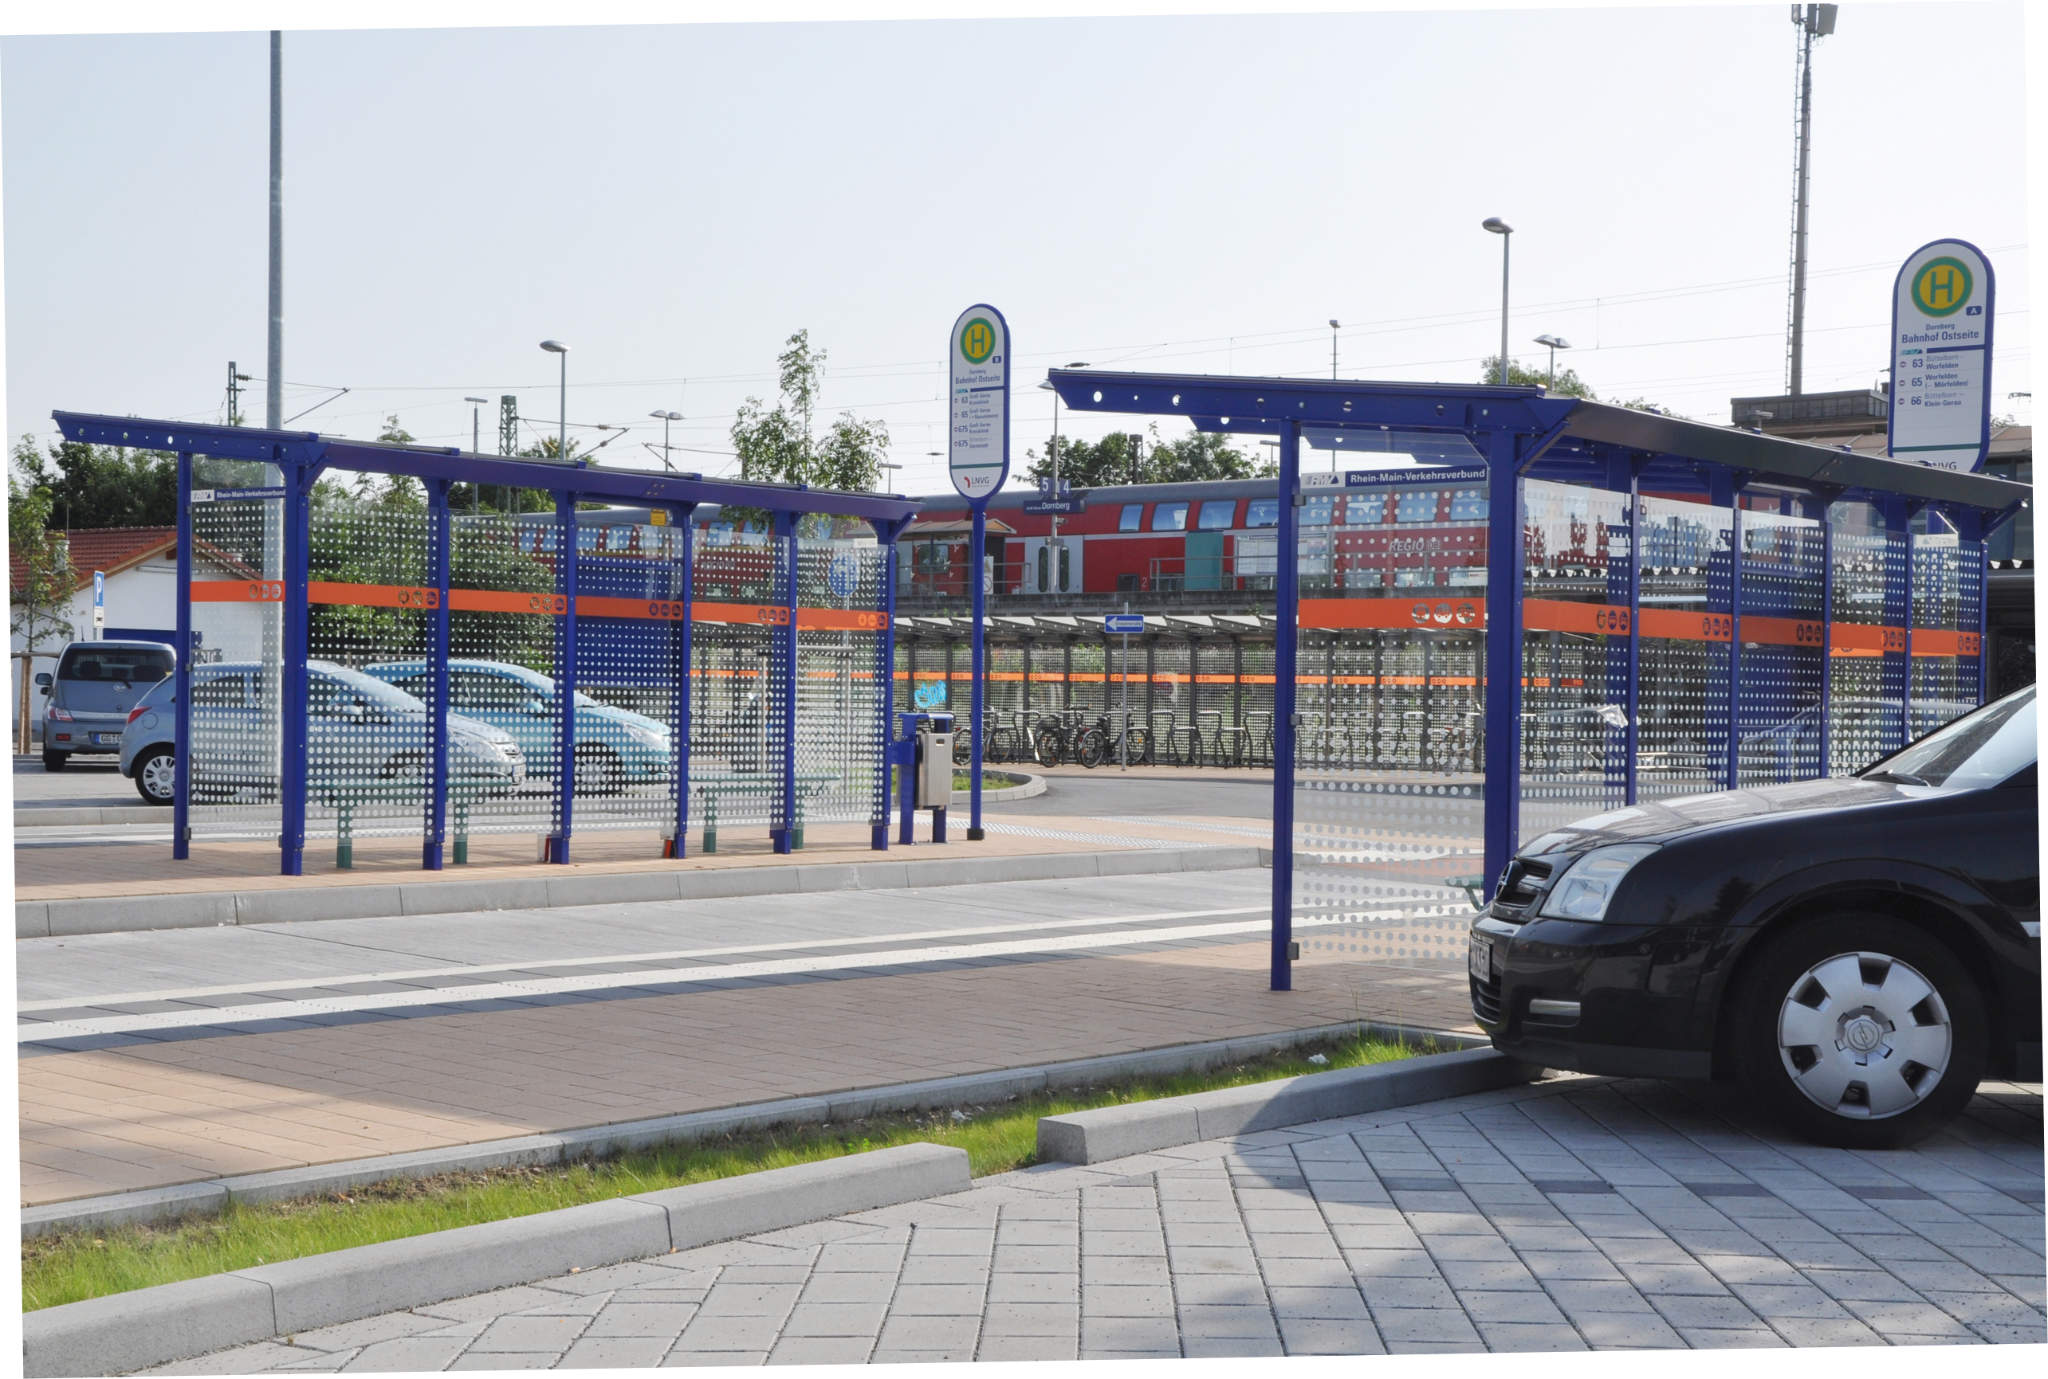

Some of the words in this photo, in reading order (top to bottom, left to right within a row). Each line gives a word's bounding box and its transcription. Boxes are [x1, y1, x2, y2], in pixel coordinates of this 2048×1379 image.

[1930, 270, 1954, 304] H
[971, 327, 985, 354] H
[1902, 332, 1939, 344] Bahnhof
[1941, 330, 1980, 341] Ostseite
[1912, 358, 1924, 368] 63
[1911, 377, 1923, 387] 65
[1911, 396, 1922, 406] 66
[1350, 468, 1486, 483] Rhein-Main-Verkehrsverbund
[1042, 477, 1049, 492] 5
[1063, 479, 1071, 494] 4
[1388, 540, 1425, 552] REGIO
[96, 576, 102, 602] P
